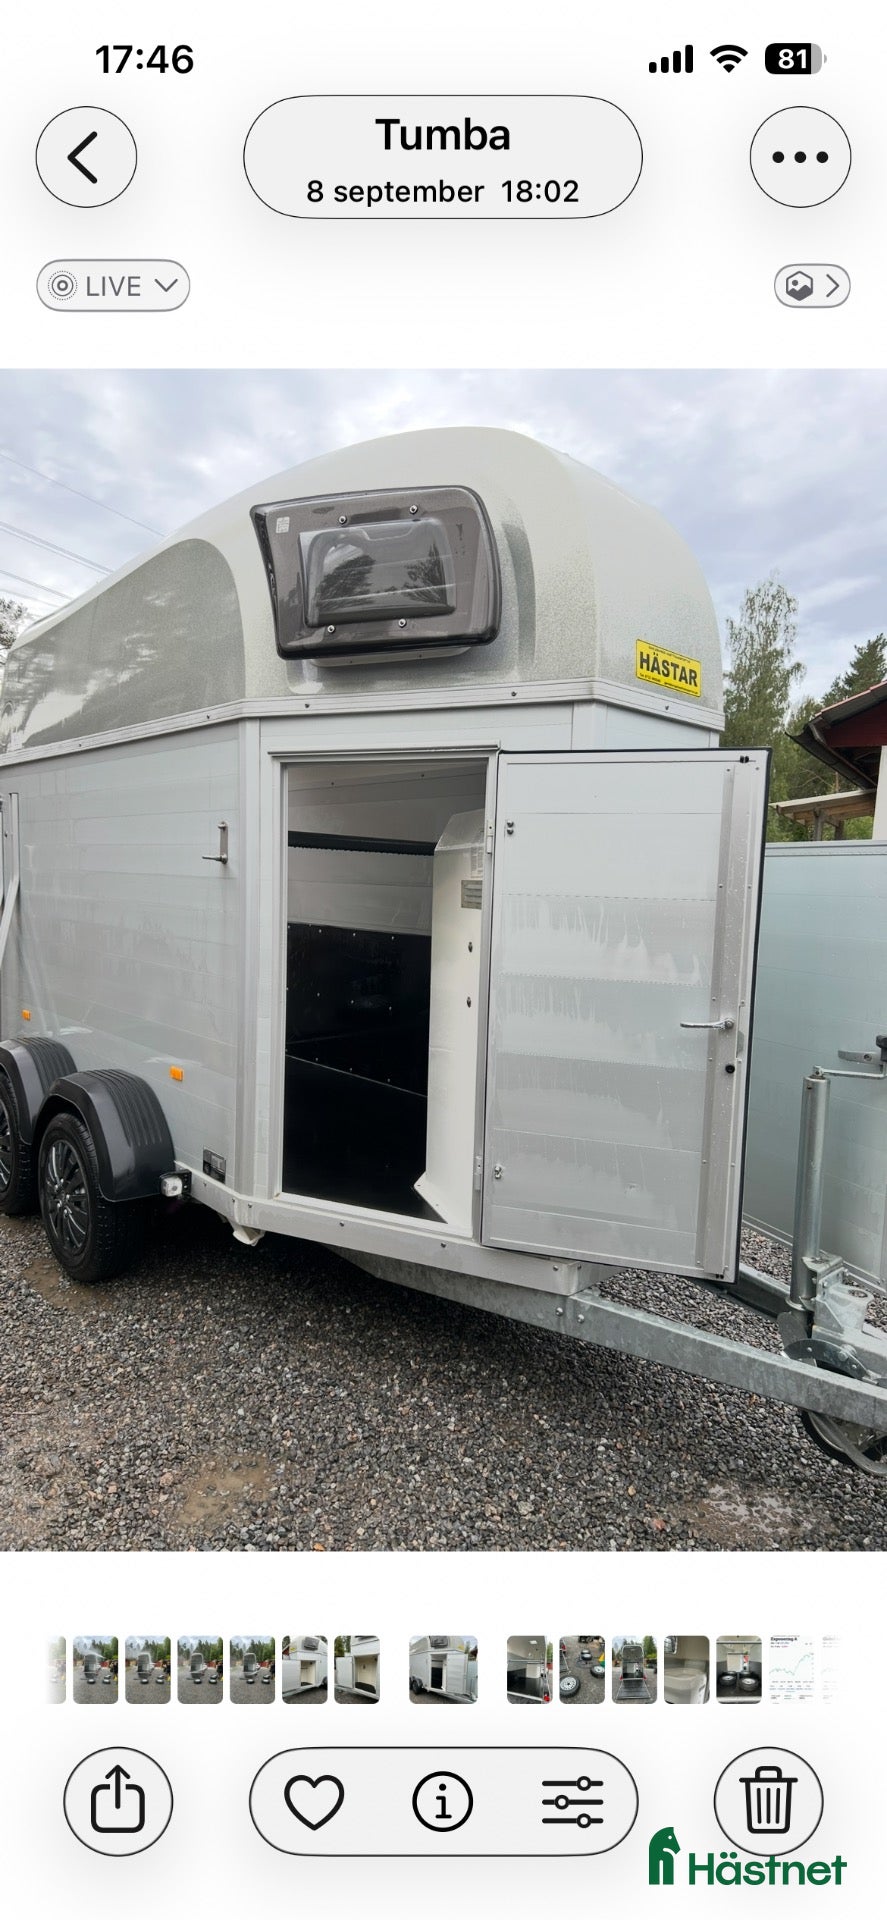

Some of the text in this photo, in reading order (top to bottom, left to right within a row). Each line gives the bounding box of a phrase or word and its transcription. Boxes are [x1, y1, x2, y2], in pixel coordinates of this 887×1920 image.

[95, 44, 194, 75] 17:46
[778, 48, 807, 69] 81
[374, 116, 511, 151] Tumba
[306, 179, 579, 208] 8 september 18:02
[86, 276, 141, 297] LIVE
[640, 651, 698, 687] HÄSTAR
